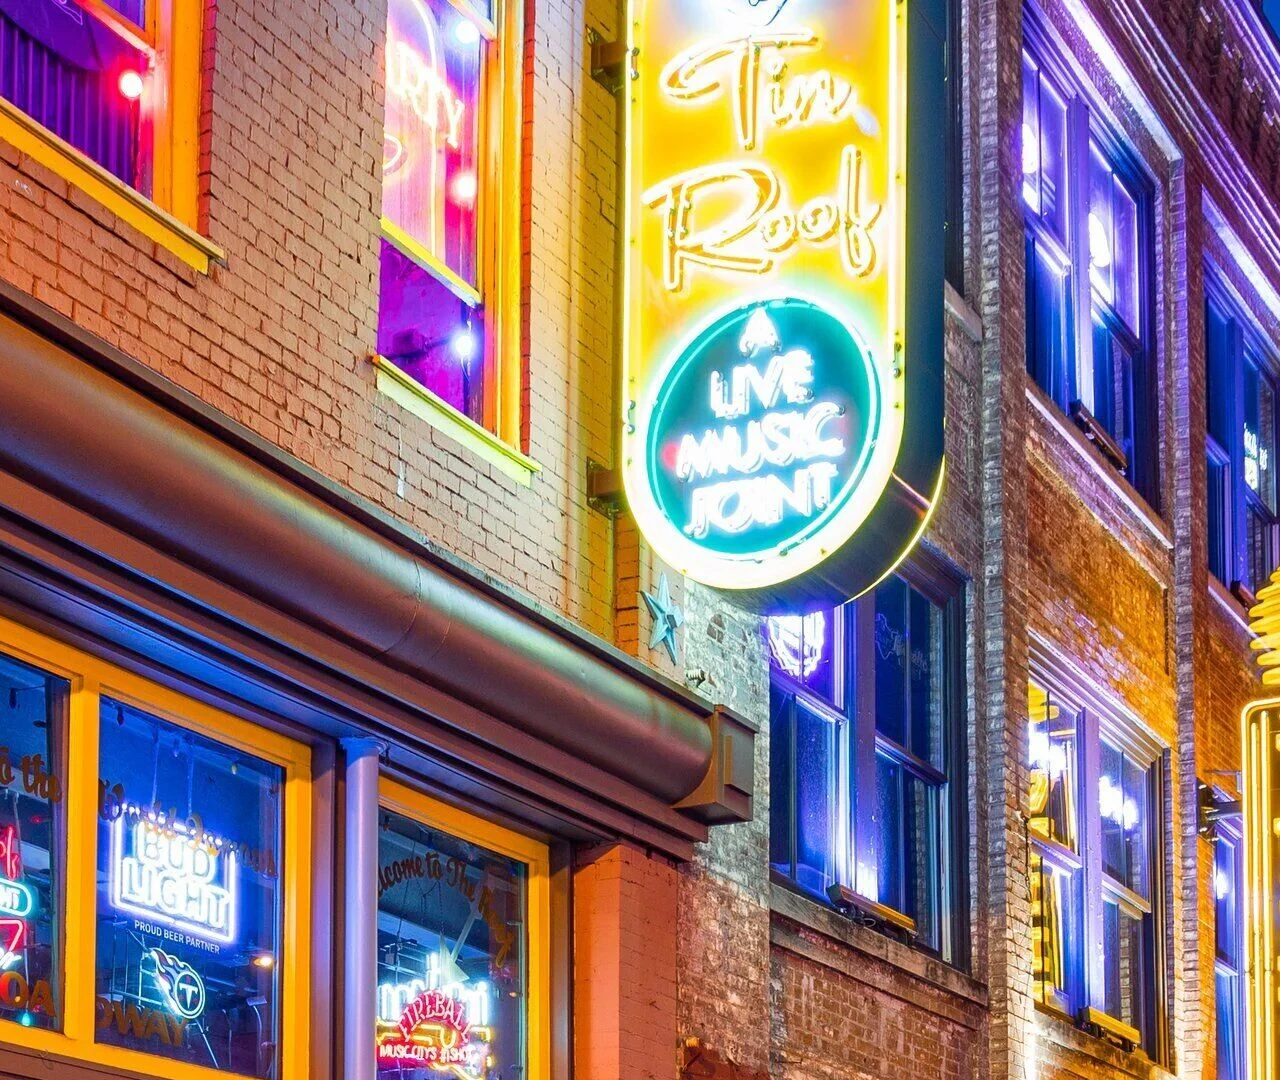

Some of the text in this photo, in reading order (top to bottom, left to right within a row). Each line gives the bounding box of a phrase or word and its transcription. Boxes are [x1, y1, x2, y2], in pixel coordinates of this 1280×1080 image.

[660, 29, 856, 150] Tin
[643, 144, 883, 293] Roof
[738, 307, 781, 358] A
[711, 350, 816, 419] LIVE
[676, 402, 847, 481] MUSIC
[684, 464, 839, 539] JOINT
[21, 753, 62, 803] the
[120, 855, 232, 930] LIGHT
[134, 918, 221, 955] PROUD BEER PARTNER
[397, 989, 473, 1044] FIREBALL
